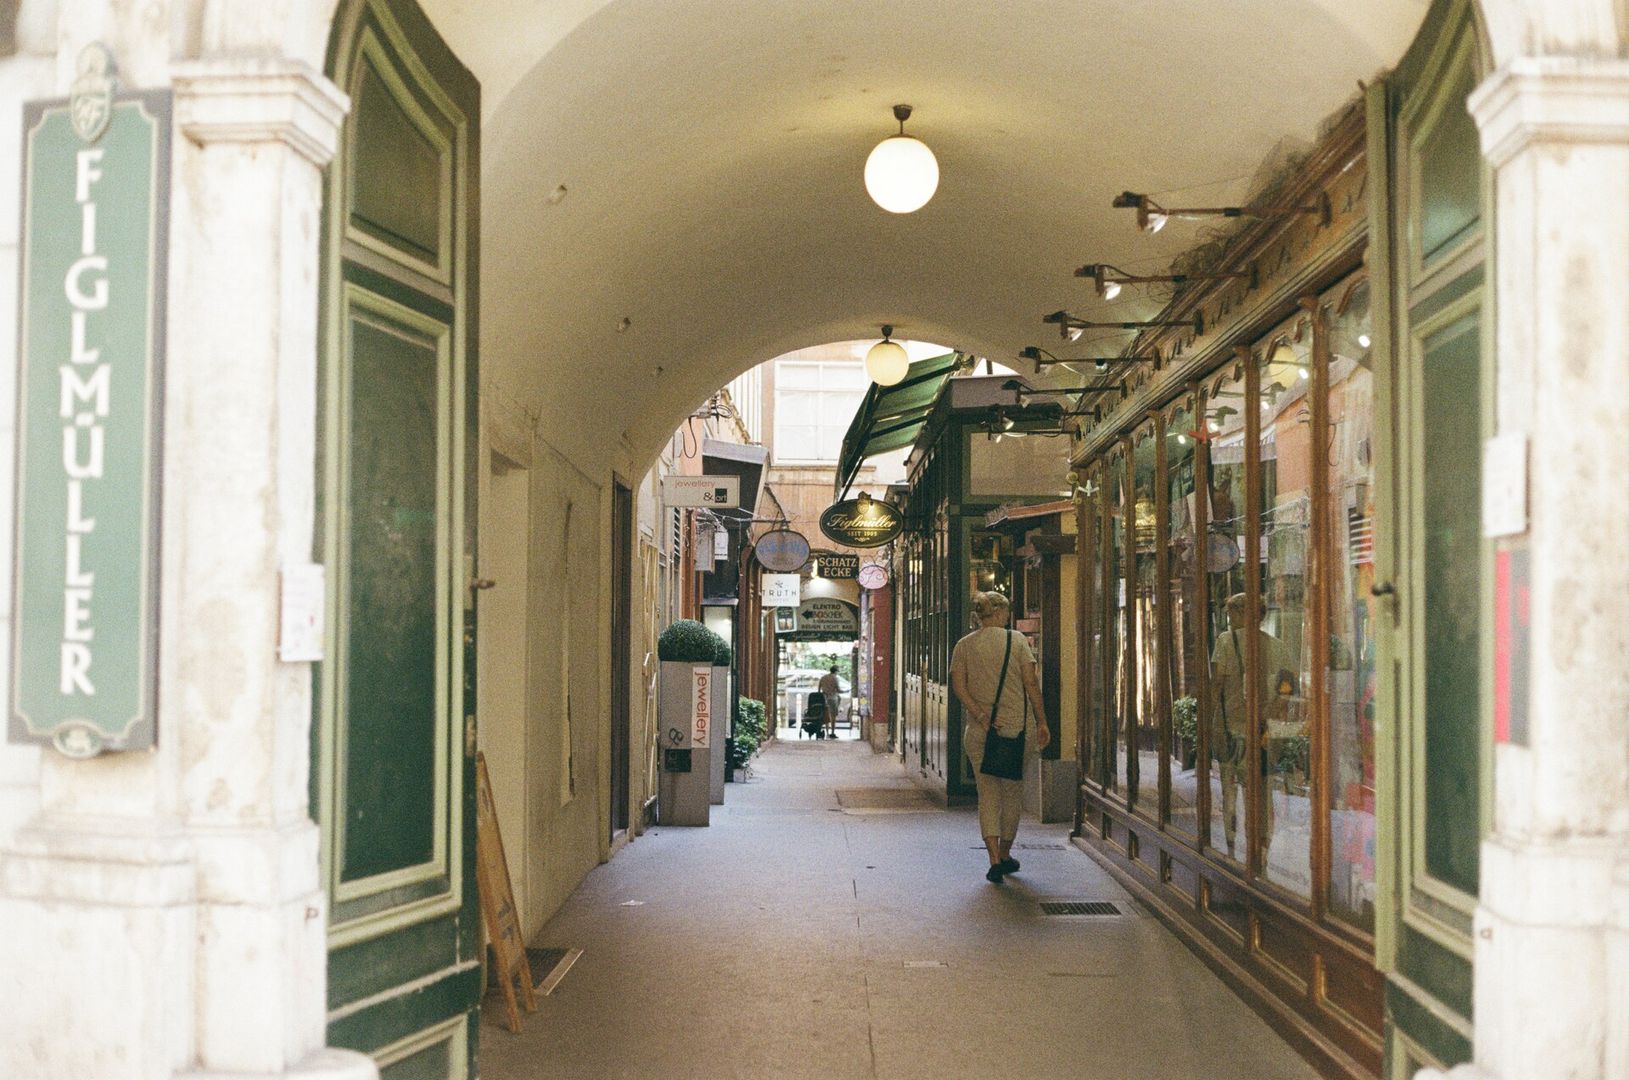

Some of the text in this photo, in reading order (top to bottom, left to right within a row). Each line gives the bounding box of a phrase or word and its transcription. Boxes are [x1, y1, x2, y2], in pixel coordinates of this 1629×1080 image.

[59, 150, 111, 696] FIGLMÜLLER
[673, 480, 715, 489] jewellery
[703, 492, 714, 501] &
[827, 514, 897, 529] Figlmüller
[819, 557, 857, 567] SCHATZ
[824, 567, 852, 577] ECKE
[693, 672, 710, 746] jewellery
[669, 728, 684, 746] &
